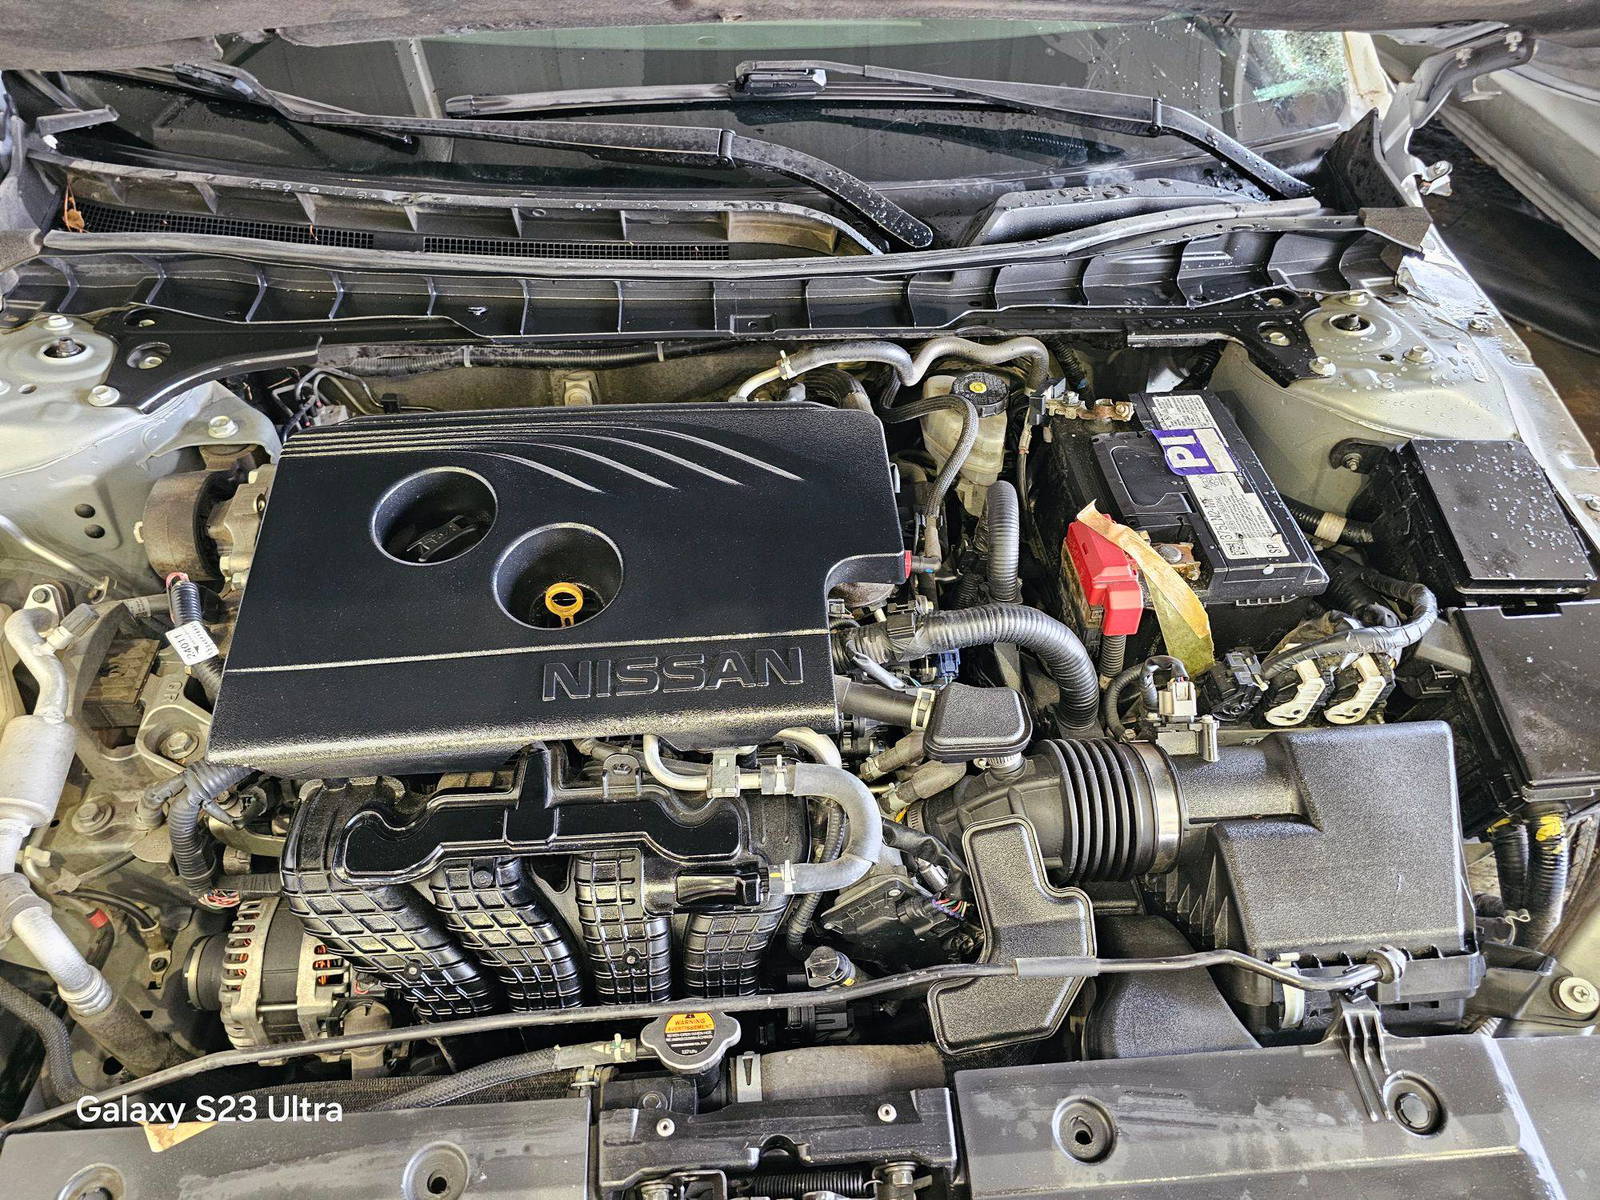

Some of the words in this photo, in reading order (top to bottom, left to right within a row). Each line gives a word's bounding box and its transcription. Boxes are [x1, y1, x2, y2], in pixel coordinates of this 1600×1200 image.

[1266, 543, 1282, 554] SP
[542, 646, 804, 702] NISSAN
[674, 1017, 706, 1026] WARNING
